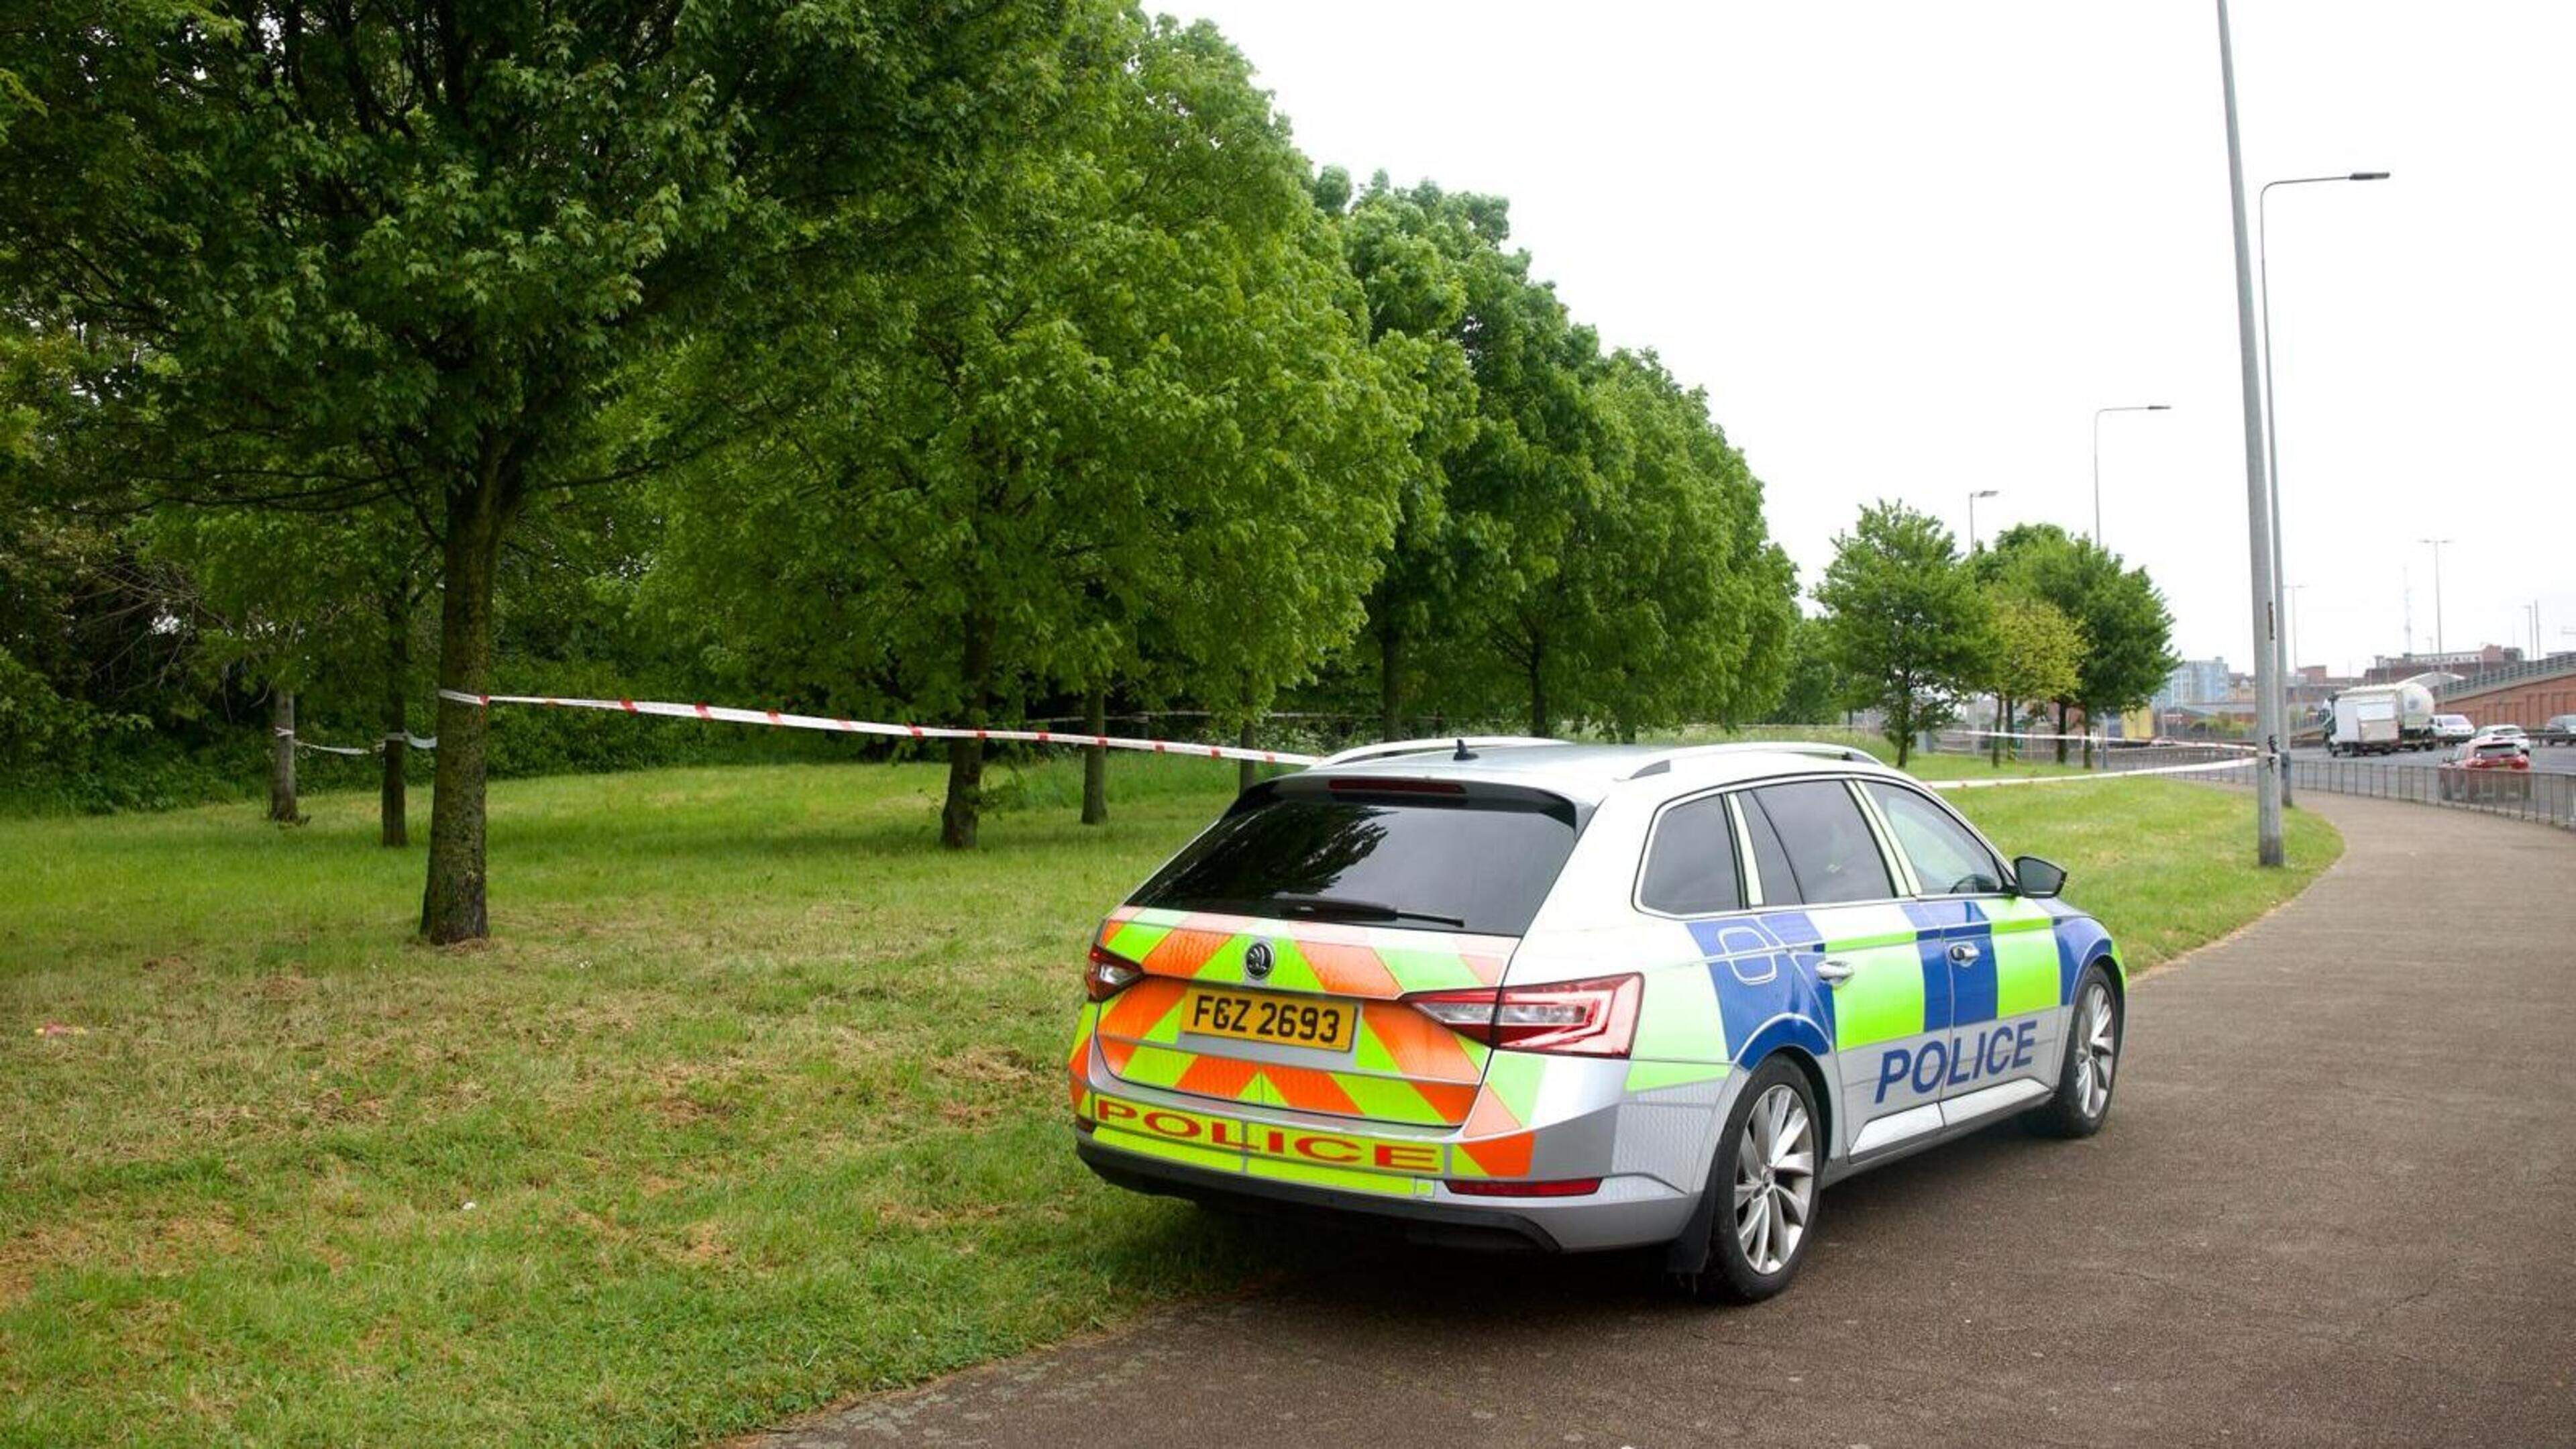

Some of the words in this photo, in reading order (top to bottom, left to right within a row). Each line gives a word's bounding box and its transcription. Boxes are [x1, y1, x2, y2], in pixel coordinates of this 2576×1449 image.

[1193, 994, 1252, 1032] FGZ
[1256, 1002, 1340, 1043] 2693
[1875, 1020, 2037, 1104] POLICE
[1097, 1099, 1438, 1171] POLICE
